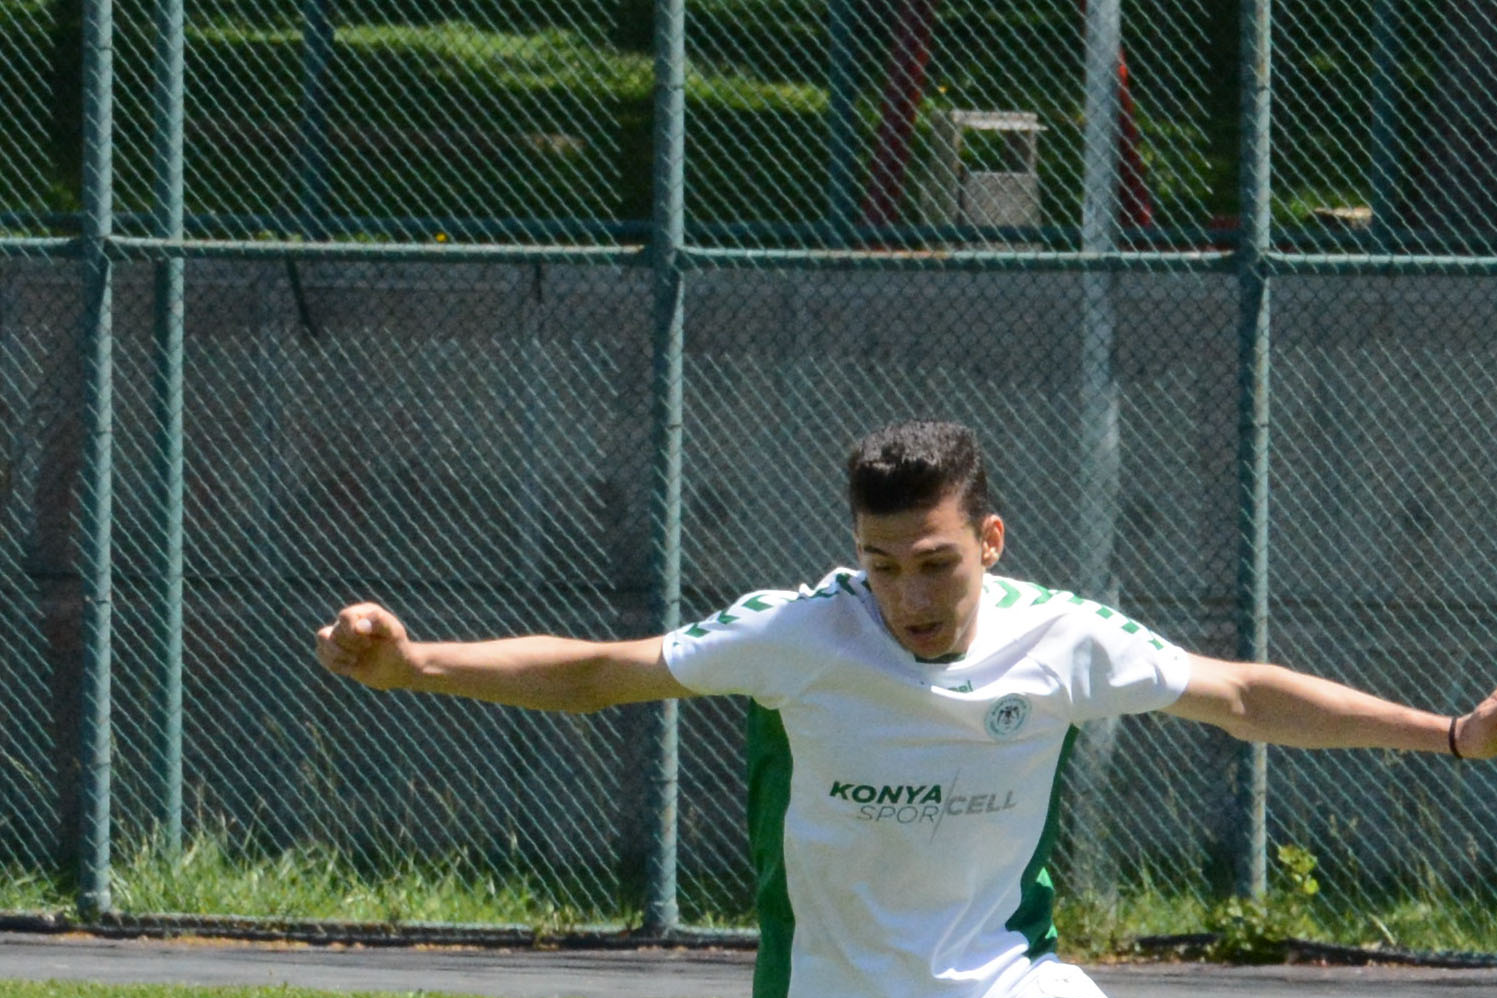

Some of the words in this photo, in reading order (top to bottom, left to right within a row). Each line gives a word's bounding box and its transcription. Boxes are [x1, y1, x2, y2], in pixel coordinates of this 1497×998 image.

[829, 780, 942, 805] KONYA
[944, 789, 1017, 817] CELL
[857, 804, 940, 825] SPOR
